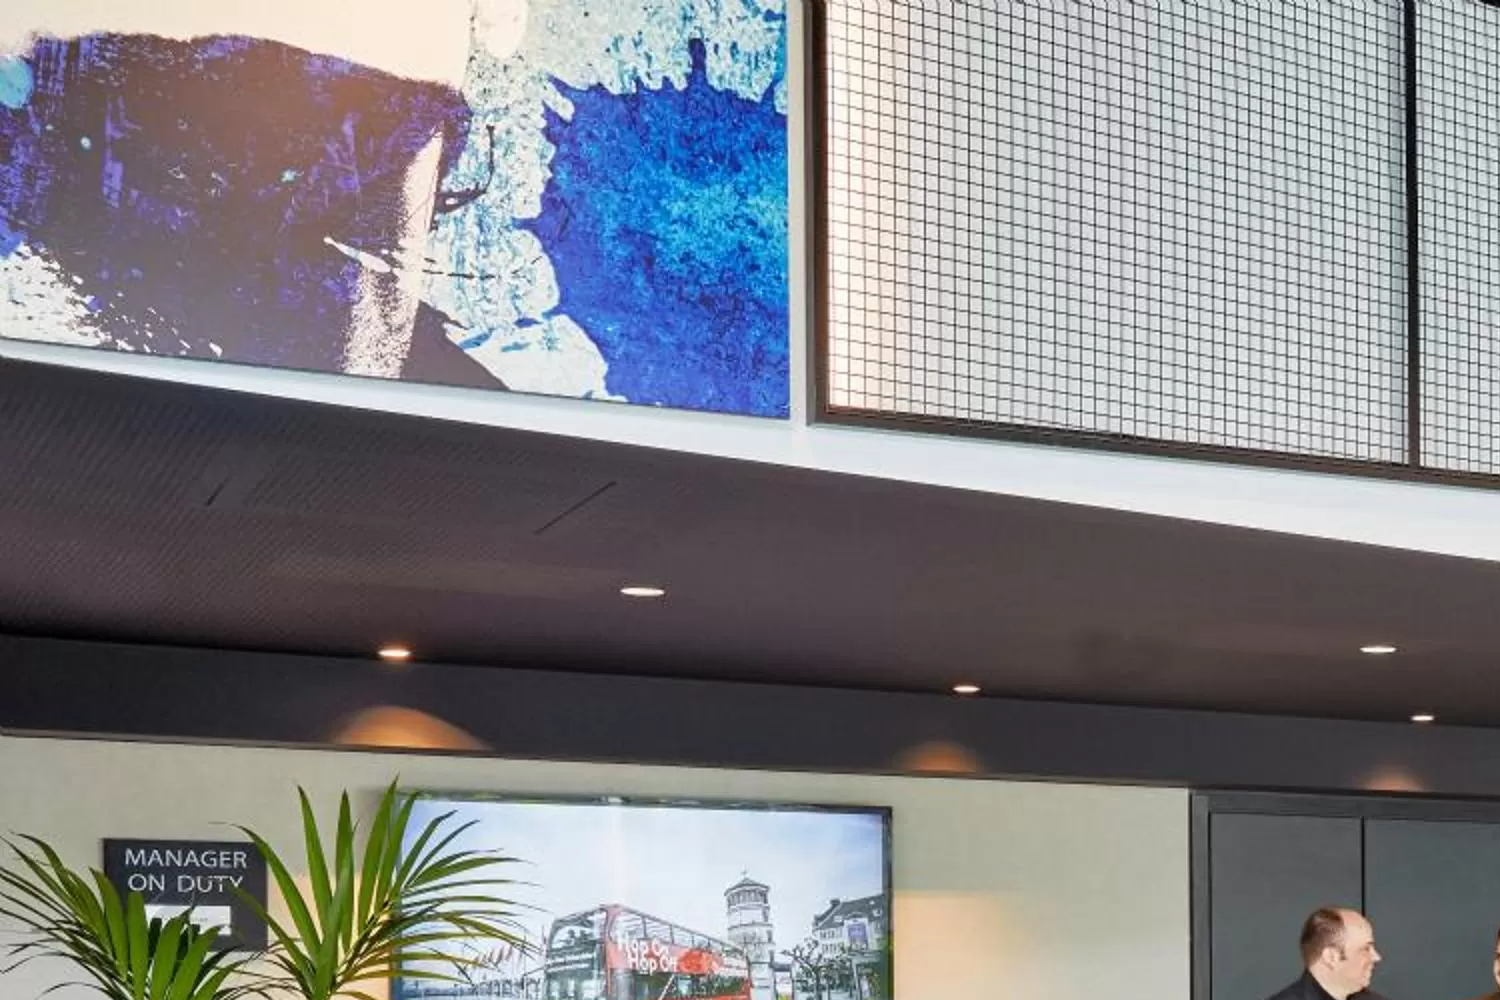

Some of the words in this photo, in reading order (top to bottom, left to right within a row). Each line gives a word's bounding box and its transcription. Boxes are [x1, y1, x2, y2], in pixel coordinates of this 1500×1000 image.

[125, 848, 247, 868] MANAGER
[128, 873, 165, 892] ON
[177, 875, 244, 893] DUTY
